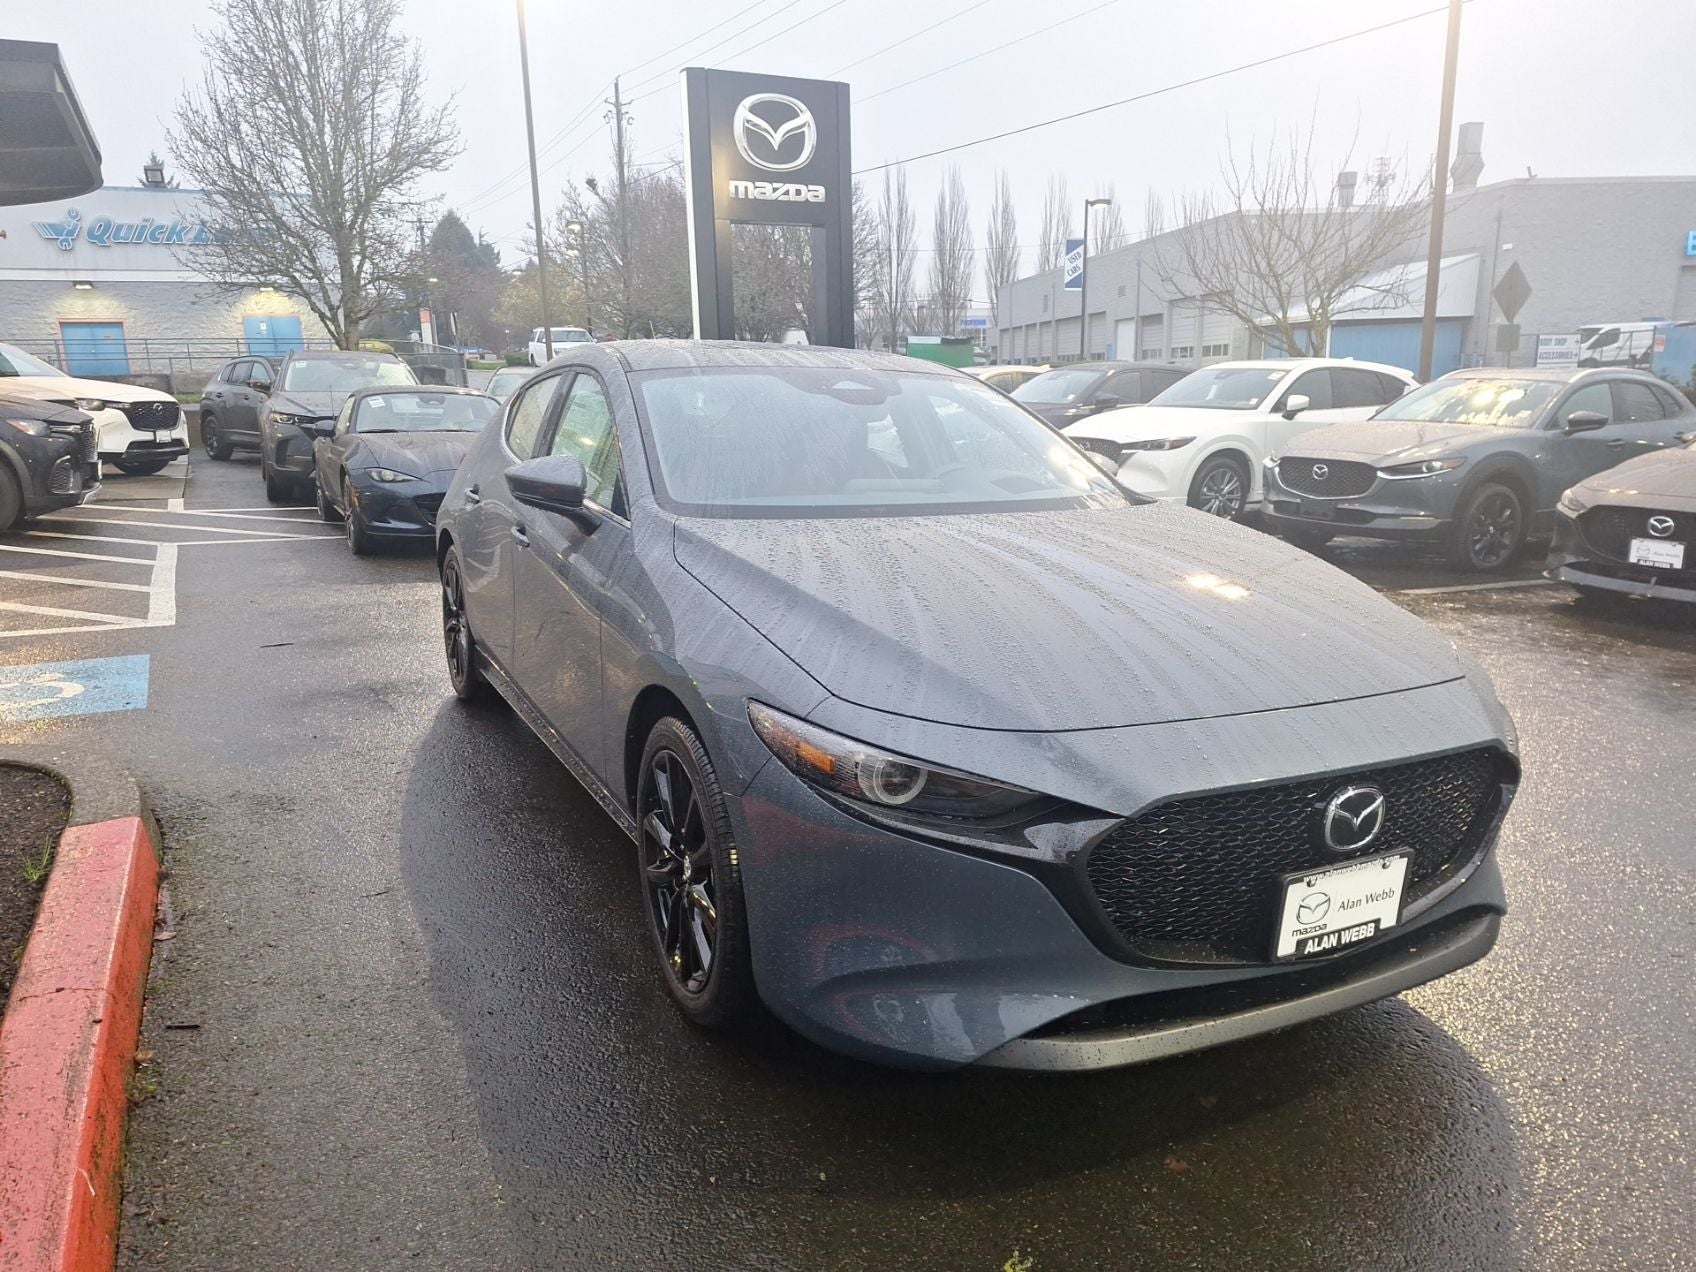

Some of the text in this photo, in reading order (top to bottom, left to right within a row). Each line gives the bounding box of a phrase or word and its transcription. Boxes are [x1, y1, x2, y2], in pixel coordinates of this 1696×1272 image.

[86, 214, 191, 246] Quick
[1067, 251, 1081, 264] USED
[1067, 264, 1081, 277] CARS
[1337, 888, 1395, 912] Alan Webb
[1304, 922, 1376, 955] ALAN WEBB
